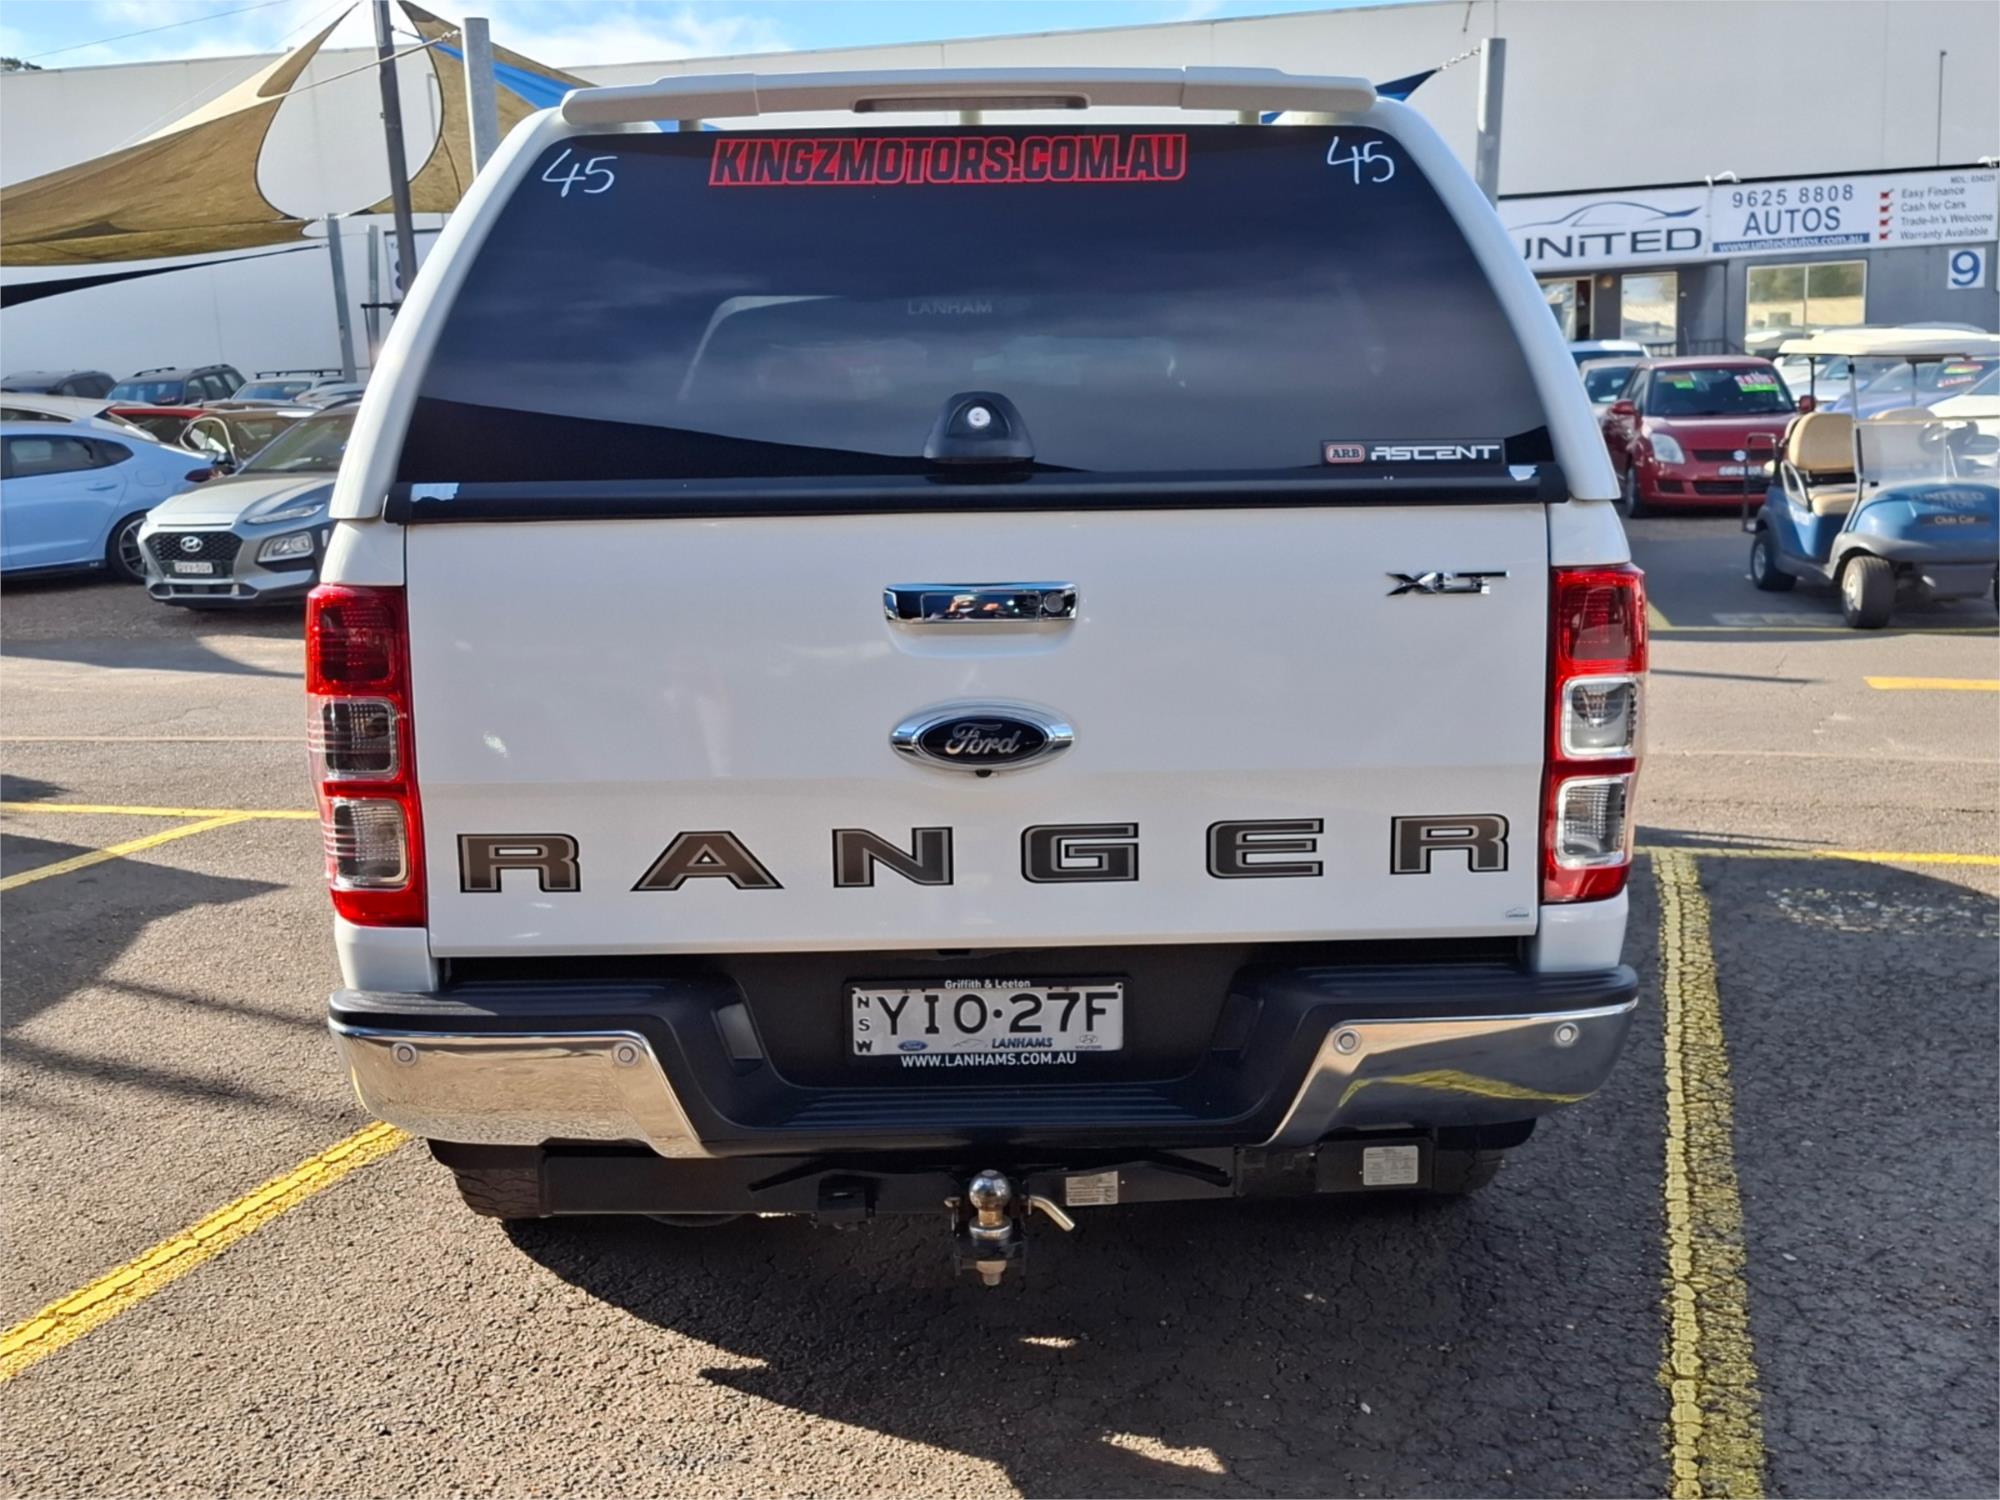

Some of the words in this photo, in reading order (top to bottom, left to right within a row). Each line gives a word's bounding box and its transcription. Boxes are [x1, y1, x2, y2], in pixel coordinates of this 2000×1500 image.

[709, 134, 1186, 186] KINGZMOTORS.COM.AU
[1327, 136, 1395, 184] 45
[542, 148, 618, 197] 45
[1732, 188, 1787, 208] 9625
[1799, 184, 1853, 204] 8808
[1901, 189, 1925, 200] Easy
[1927, 186, 1966, 197] Finance
[1901, 202, 1926, 213] Cash
[1928, 202, 1941, 211] for
[1944, 200, 1967, 210] Cars
[1743, 205, 1841, 237] AUTOS
[1950, 213, 1994, 224] Welcome
[1718, 234, 1865, 253] www.unitedautos.com.au
[1900, 230, 1942, 241] Warranty
[1945, 226, 1989, 238] Available
[1951, 250, 1981, 286] 9
[1331, 446, 1362, 459] ARB
[1371, 444, 1500, 461] ASCENT
[1385, 570, 1510, 597] XLT
[945, 722, 1022, 755] Ford
[457, 814, 1510, 893] RANGER
[944, 979, 982, 990] Griffith
[984, 979, 993, 989] &
[995, 979, 1031, 989] Leeton
[992, 1037, 1053, 1049] LANHAMS
[901, 1052, 1077, 1068] WWW.LANHAMS.COM.AU
